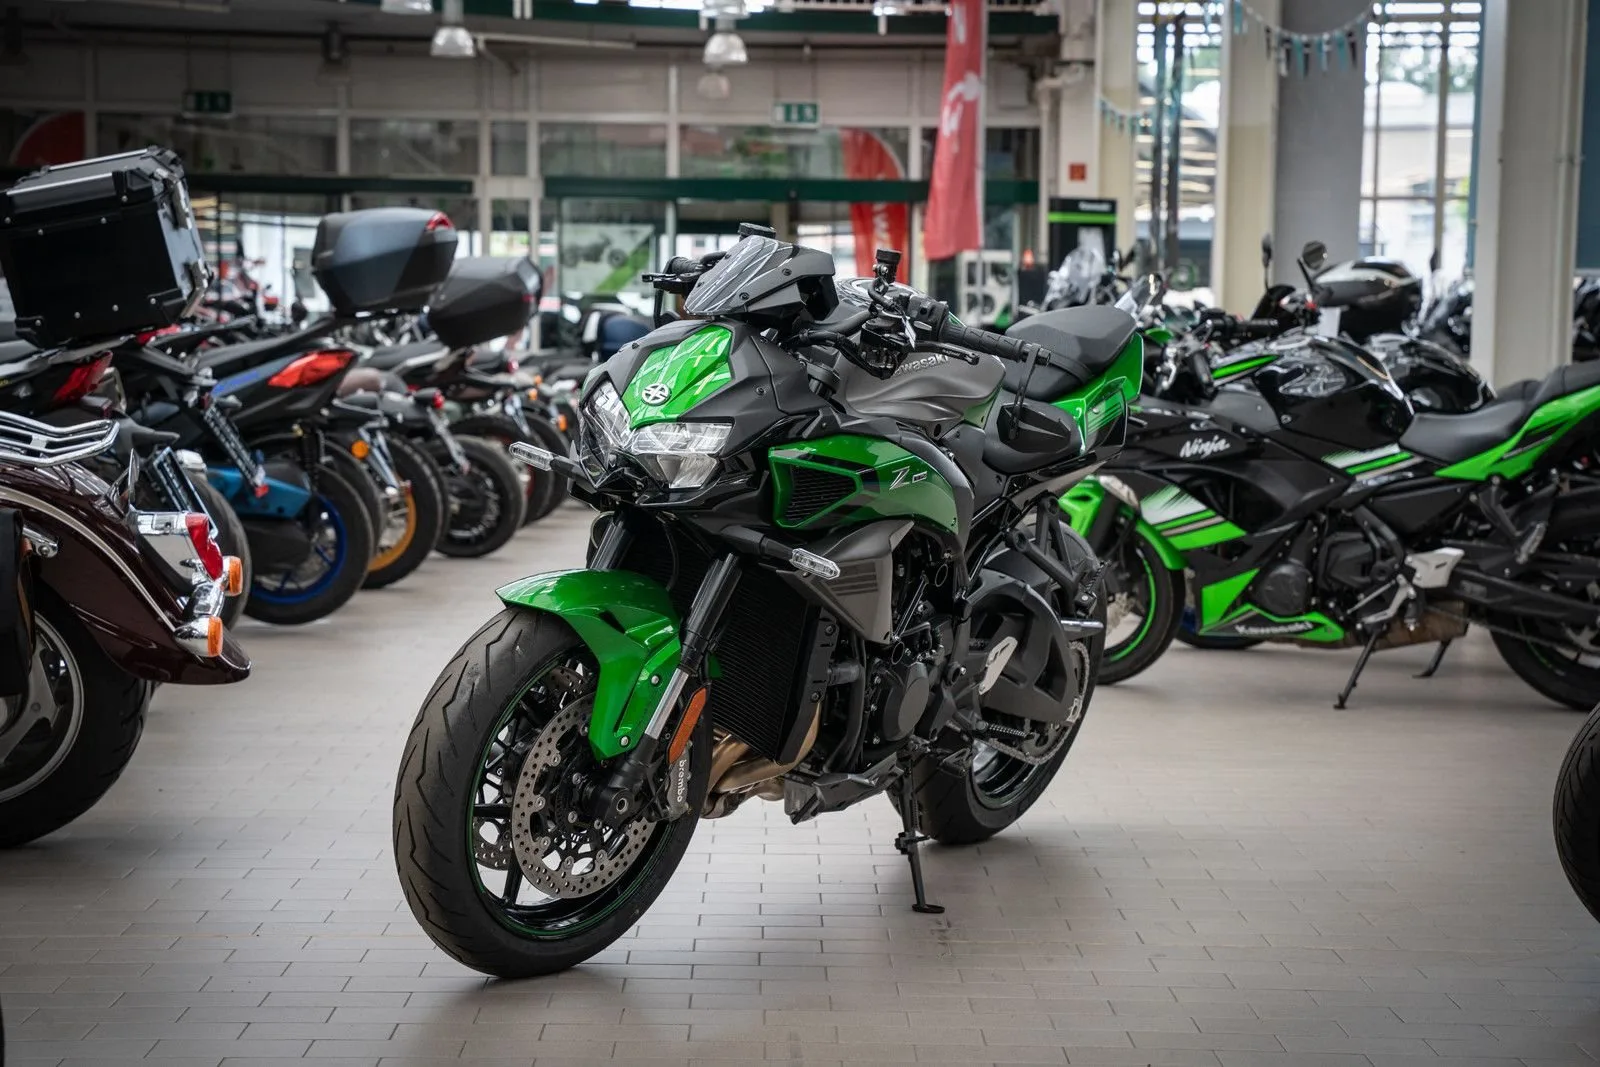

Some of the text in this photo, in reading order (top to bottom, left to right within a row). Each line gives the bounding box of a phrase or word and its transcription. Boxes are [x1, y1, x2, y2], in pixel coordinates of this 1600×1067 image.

[893, 353, 949, 376] awasaki
[1180, 435, 1230, 459] Ninja
[677, 759, 687, 803] brembo
